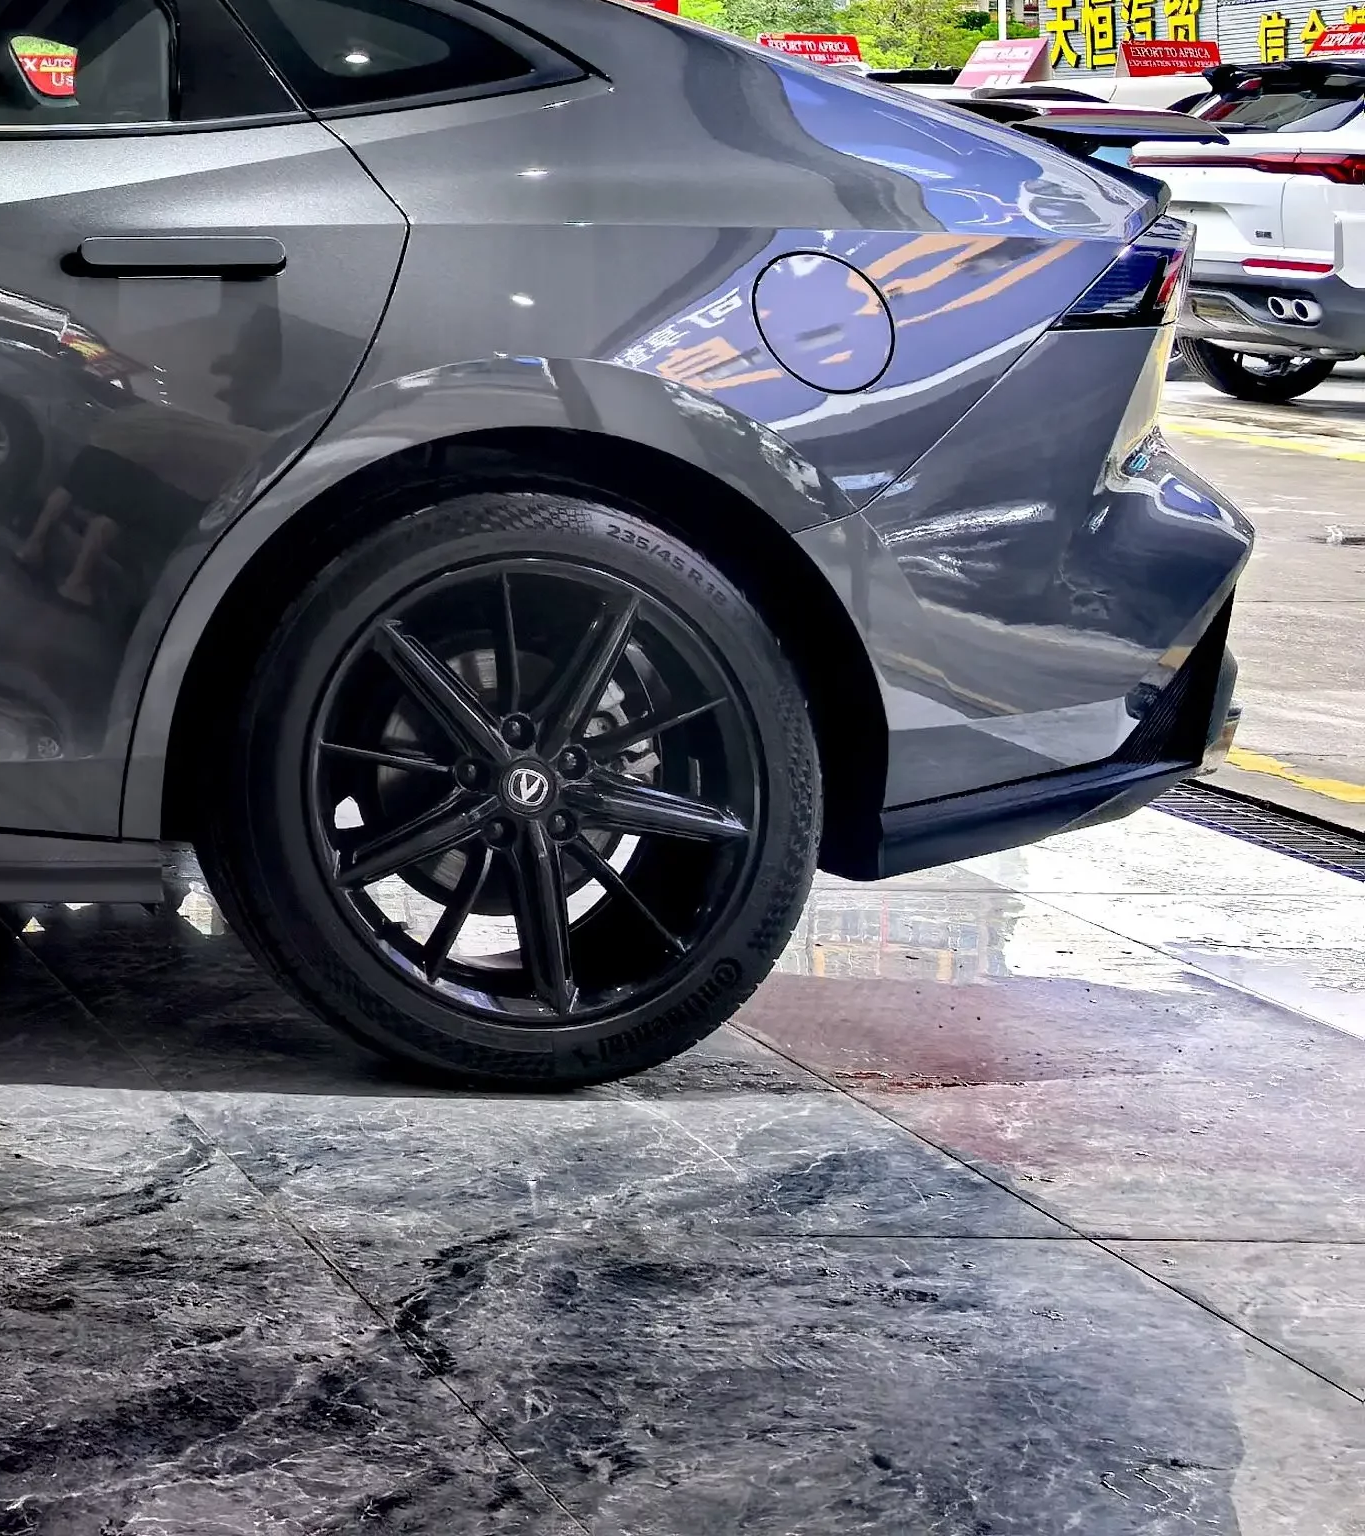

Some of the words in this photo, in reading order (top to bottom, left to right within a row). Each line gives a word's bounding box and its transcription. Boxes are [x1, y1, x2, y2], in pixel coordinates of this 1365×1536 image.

[818, 41, 851, 53] AFRICA
[1130, 46, 1163, 58] EXPORT
[1164, 46, 1177, 58] TO
[1179, 47, 1211, 59] AFRICA
[19, 58, 38, 72] X
[40, 58, 72, 67] AUTO
[606, 524, 685, 572] 235/45
